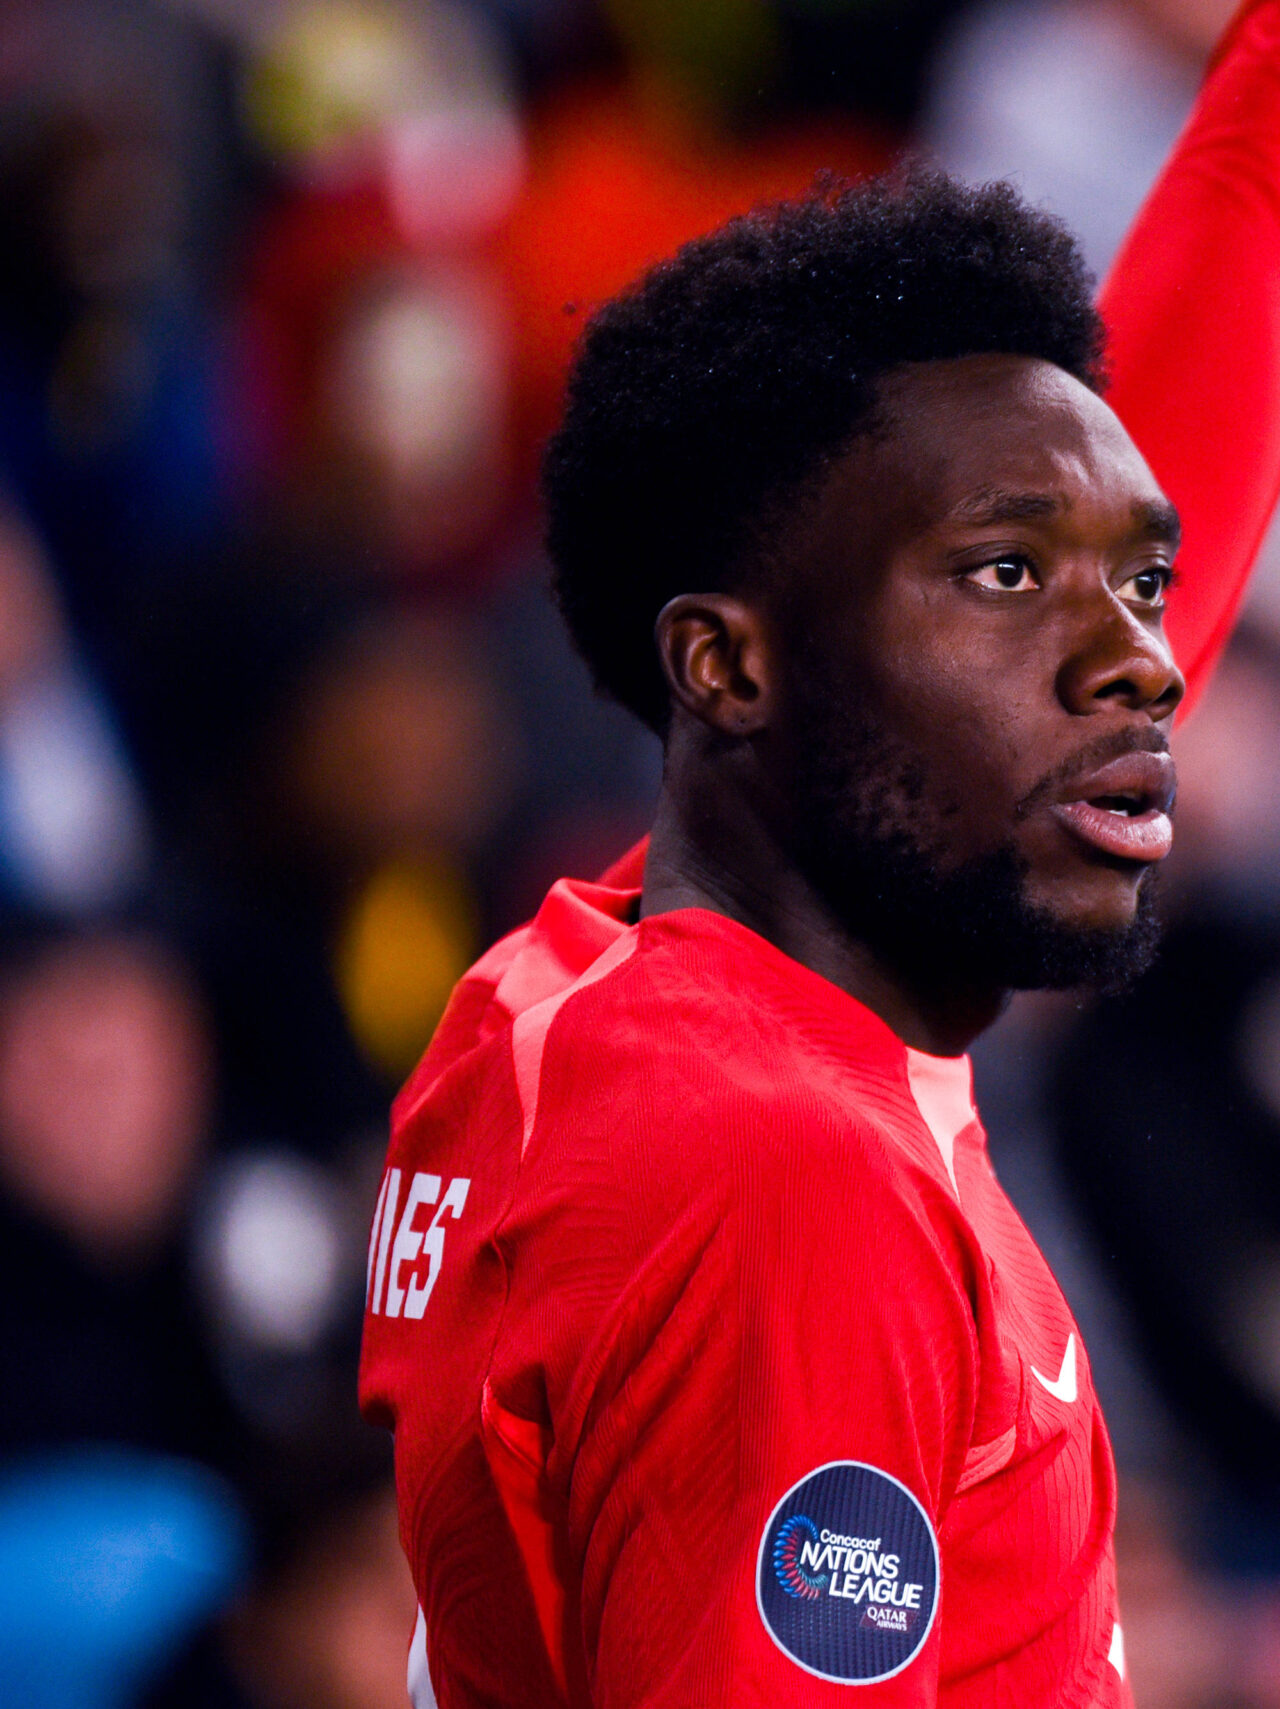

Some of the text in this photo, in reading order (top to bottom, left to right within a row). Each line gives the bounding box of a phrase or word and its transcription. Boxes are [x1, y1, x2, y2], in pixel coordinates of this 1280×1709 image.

[365, 1166, 471, 1319] IES
[820, 1529, 881, 1551] Concacaf
[800, 1541, 900, 1579] NATIONS
[829, 1572, 923, 1609] LEAGUE
[867, 1606, 907, 1623] QATAR
[876, 1620, 907, 1632] AIRWAYS
